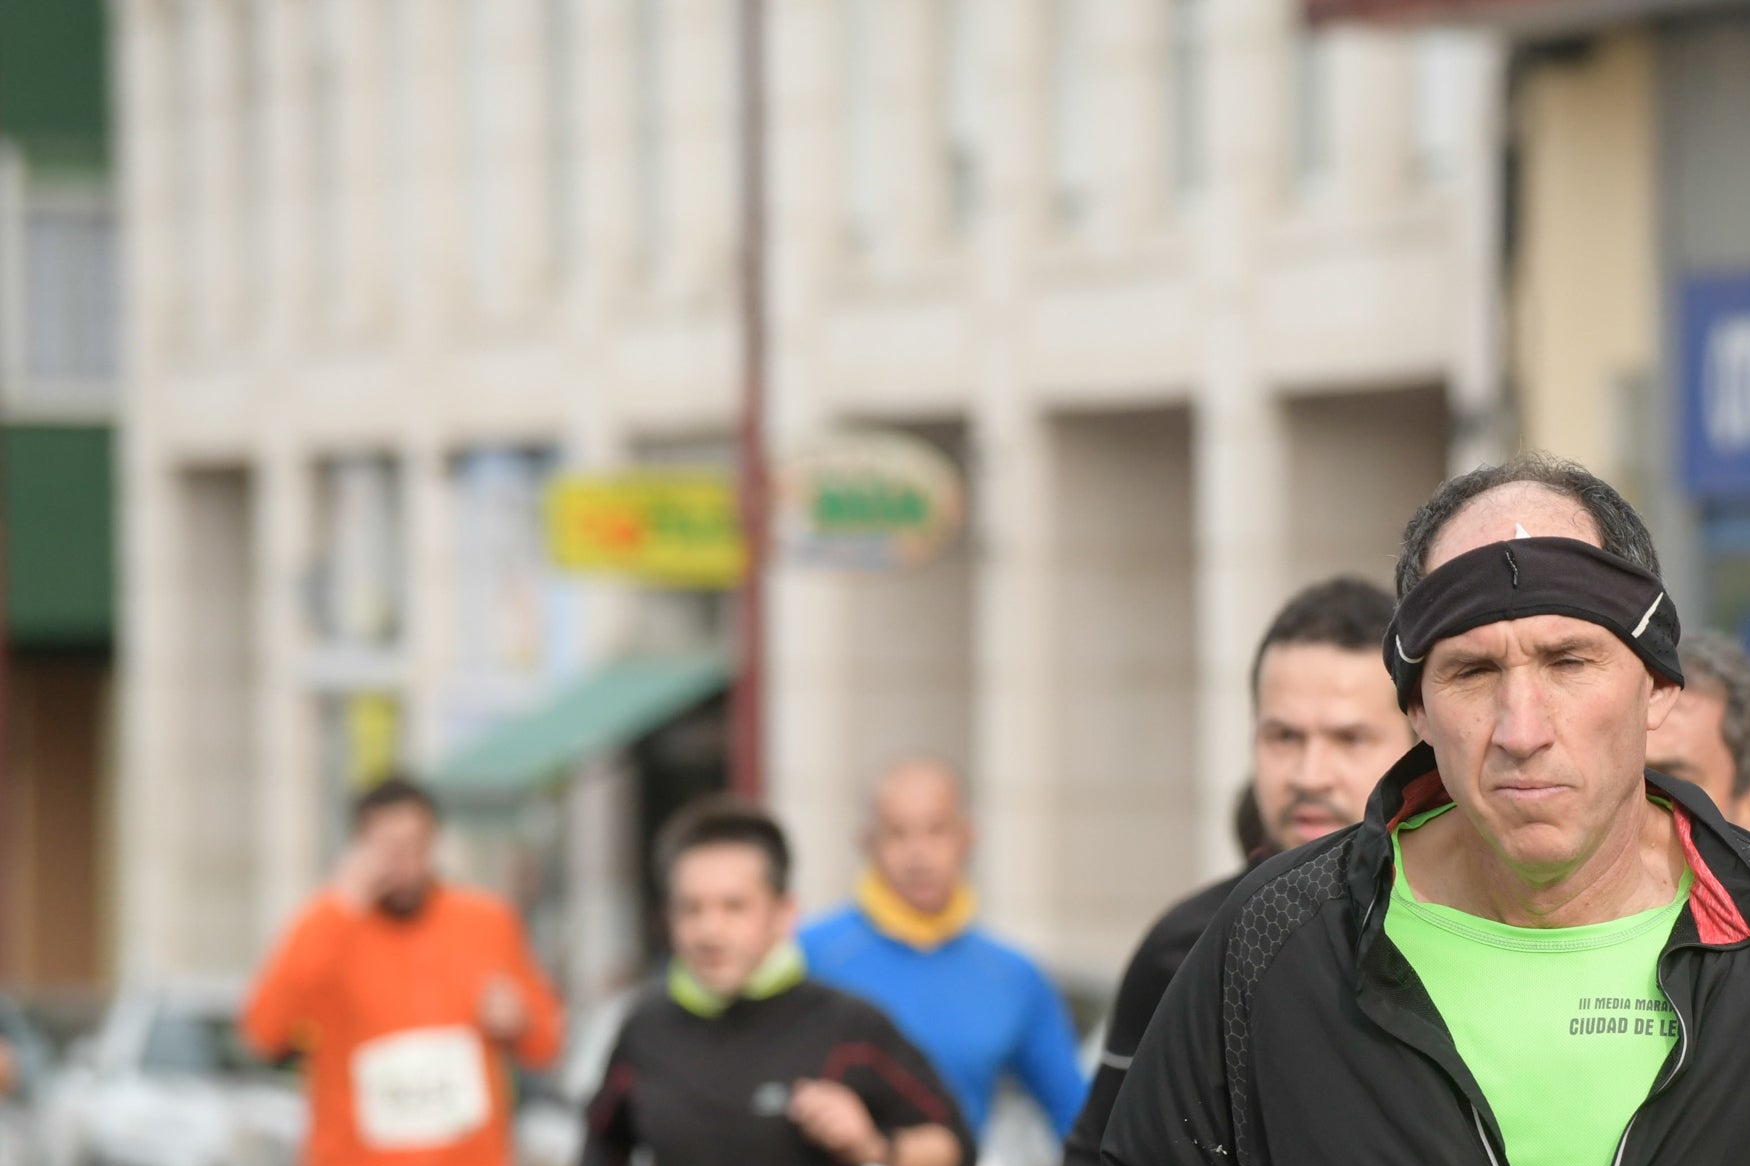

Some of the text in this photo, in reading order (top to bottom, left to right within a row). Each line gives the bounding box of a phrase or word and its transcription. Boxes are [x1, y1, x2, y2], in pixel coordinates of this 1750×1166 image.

[1578, 997, 1592, 1010] III
[1594, 997, 1631, 1010] MEDIA
[1568, 1017, 1681, 1038] CIUDAD DE LE
